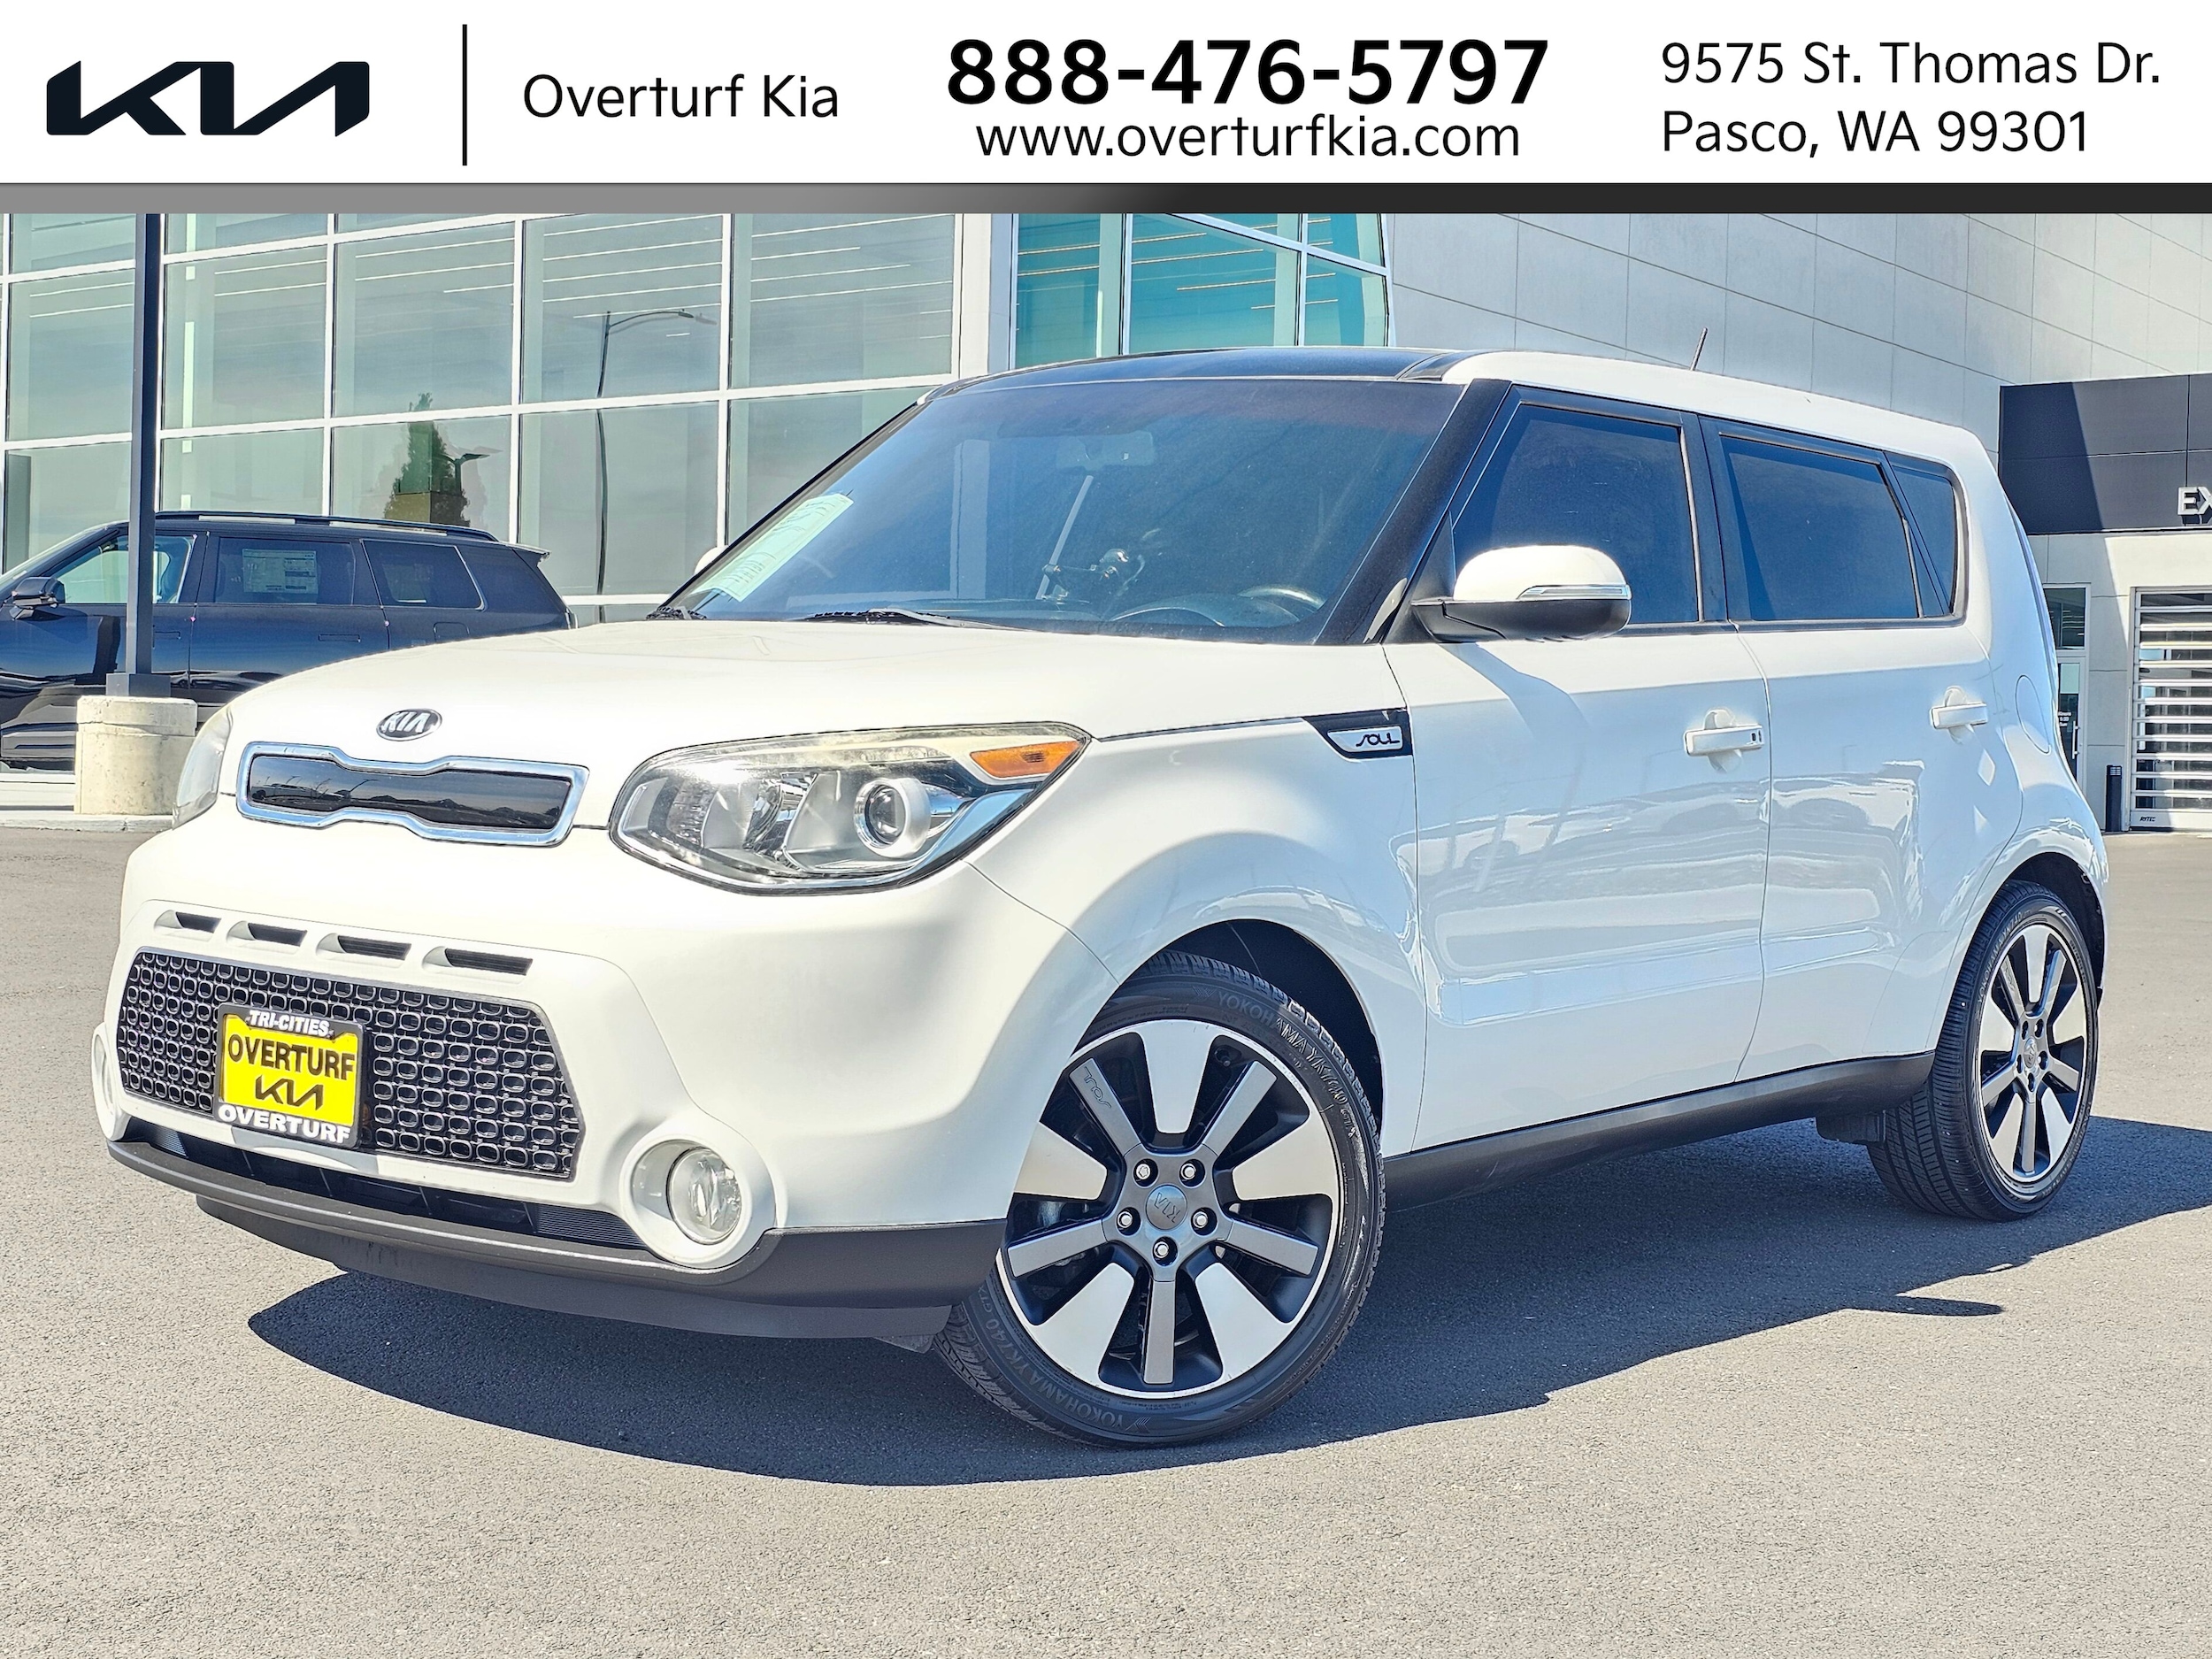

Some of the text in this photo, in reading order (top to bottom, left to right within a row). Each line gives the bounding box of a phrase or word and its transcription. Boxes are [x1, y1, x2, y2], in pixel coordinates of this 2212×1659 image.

[2177, 487, 2212, 514] EX
[380, 711, 431, 733] KIA
[1356, 733, 1401, 748] SOUL
[249, 1010, 331, 1037] TRI-CITIES
[1217, 990, 1310, 1054] YOKOHAMA
[227, 1033, 356, 1080] OVERTURF
[255, 1074, 324, 1111] KIA
[218, 1104, 351, 1144] OVERTURF
[1154, 1192, 1181, 1224] KIA
[985, 1318, 1029, 1376] YK740
[1025, 1373, 1123, 1428] YOKOHAMA
